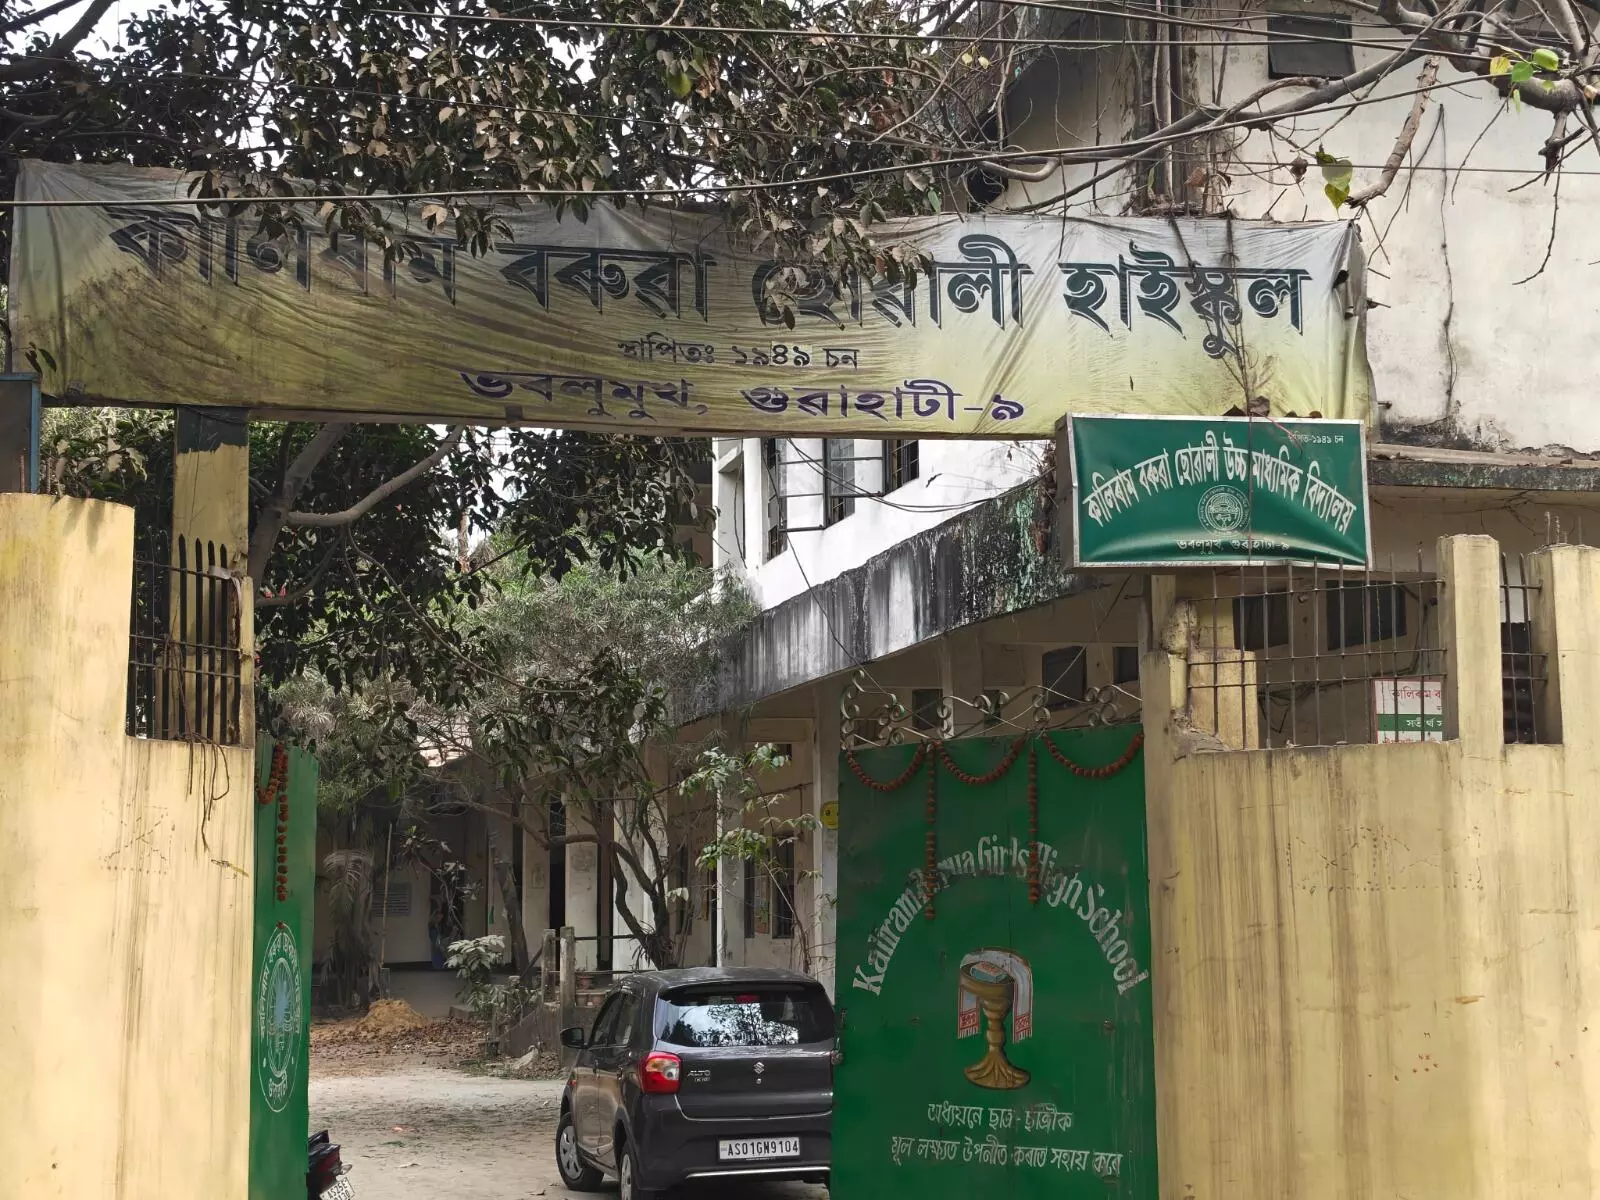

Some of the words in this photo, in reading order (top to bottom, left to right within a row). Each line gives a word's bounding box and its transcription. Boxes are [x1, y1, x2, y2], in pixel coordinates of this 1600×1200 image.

[823, 347, 860, 369] চন
[1077, 883, 1149, 996] School
[727, 1140, 799, 1157] AS01GN9104
